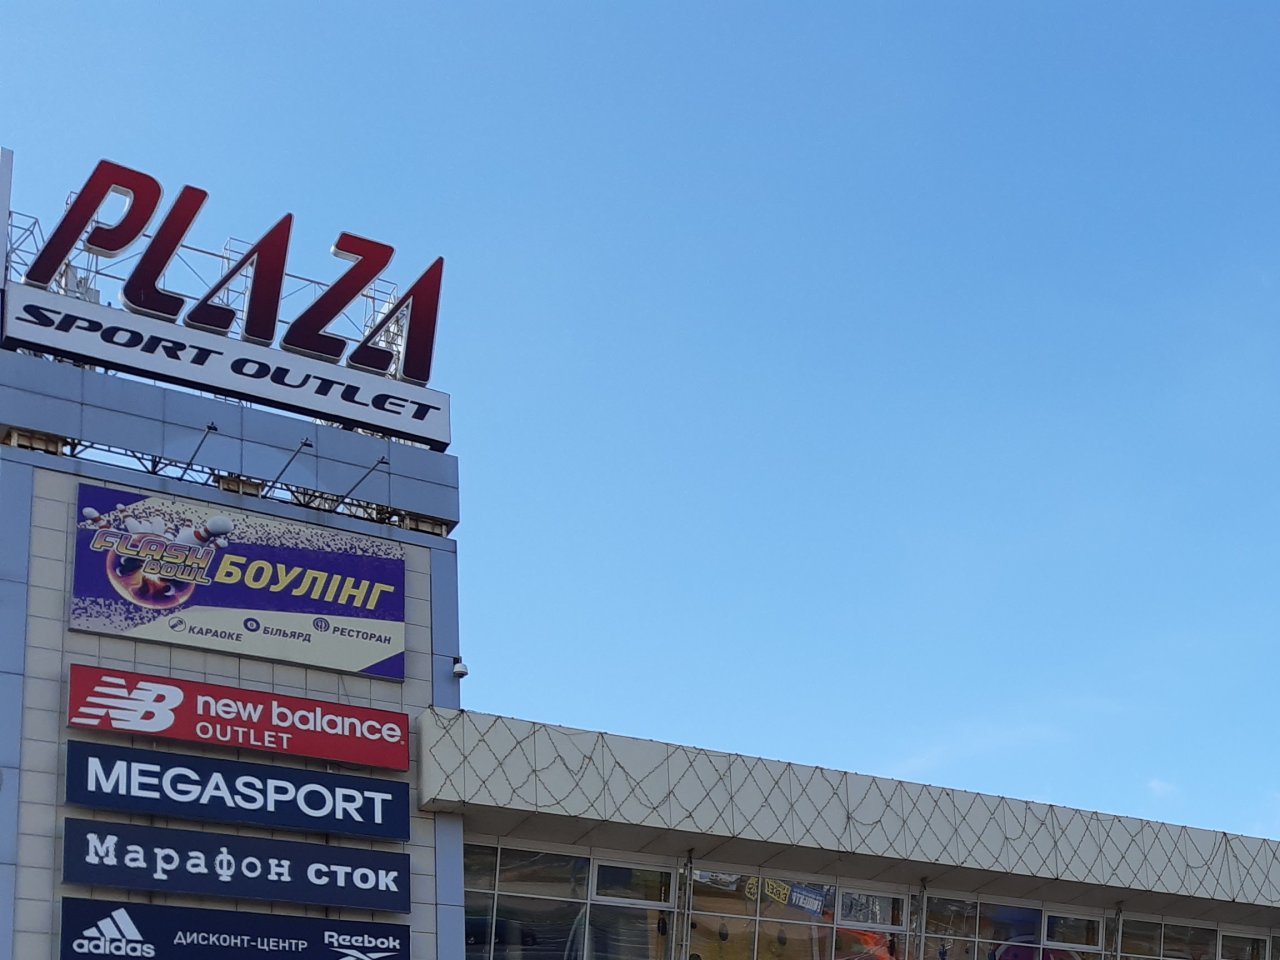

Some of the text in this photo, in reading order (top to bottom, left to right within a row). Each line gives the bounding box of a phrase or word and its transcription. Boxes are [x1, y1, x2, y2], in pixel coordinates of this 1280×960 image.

[22, 159, 444, 386] PLAZA
[14, 303, 441, 421] SPORT OUTLET
[90, 530, 215, 569] FLASH
[143, 557, 212, 585] BOWL
[214, 554, 394, 610] БОУЛІНГ
[188, 625, 243, 642] КАРАОКЕ
[263, 626, 312, 644] БІЛЬЯРД
[332, 626, 392, 645] РЕСТОРАН
[197, 695, 402, 743] new balance
[196, 722, 292, 749] OUTLET
[87, 757, 392, 824] MEGASPORT
[85, 833, 291, 881] Марафон
[73, 936, 155, 957] adidas
[174, 931, 308, 952] ДИСКОНТ-ЦЕНТР
[324, 931, 400, 950] Reebok
